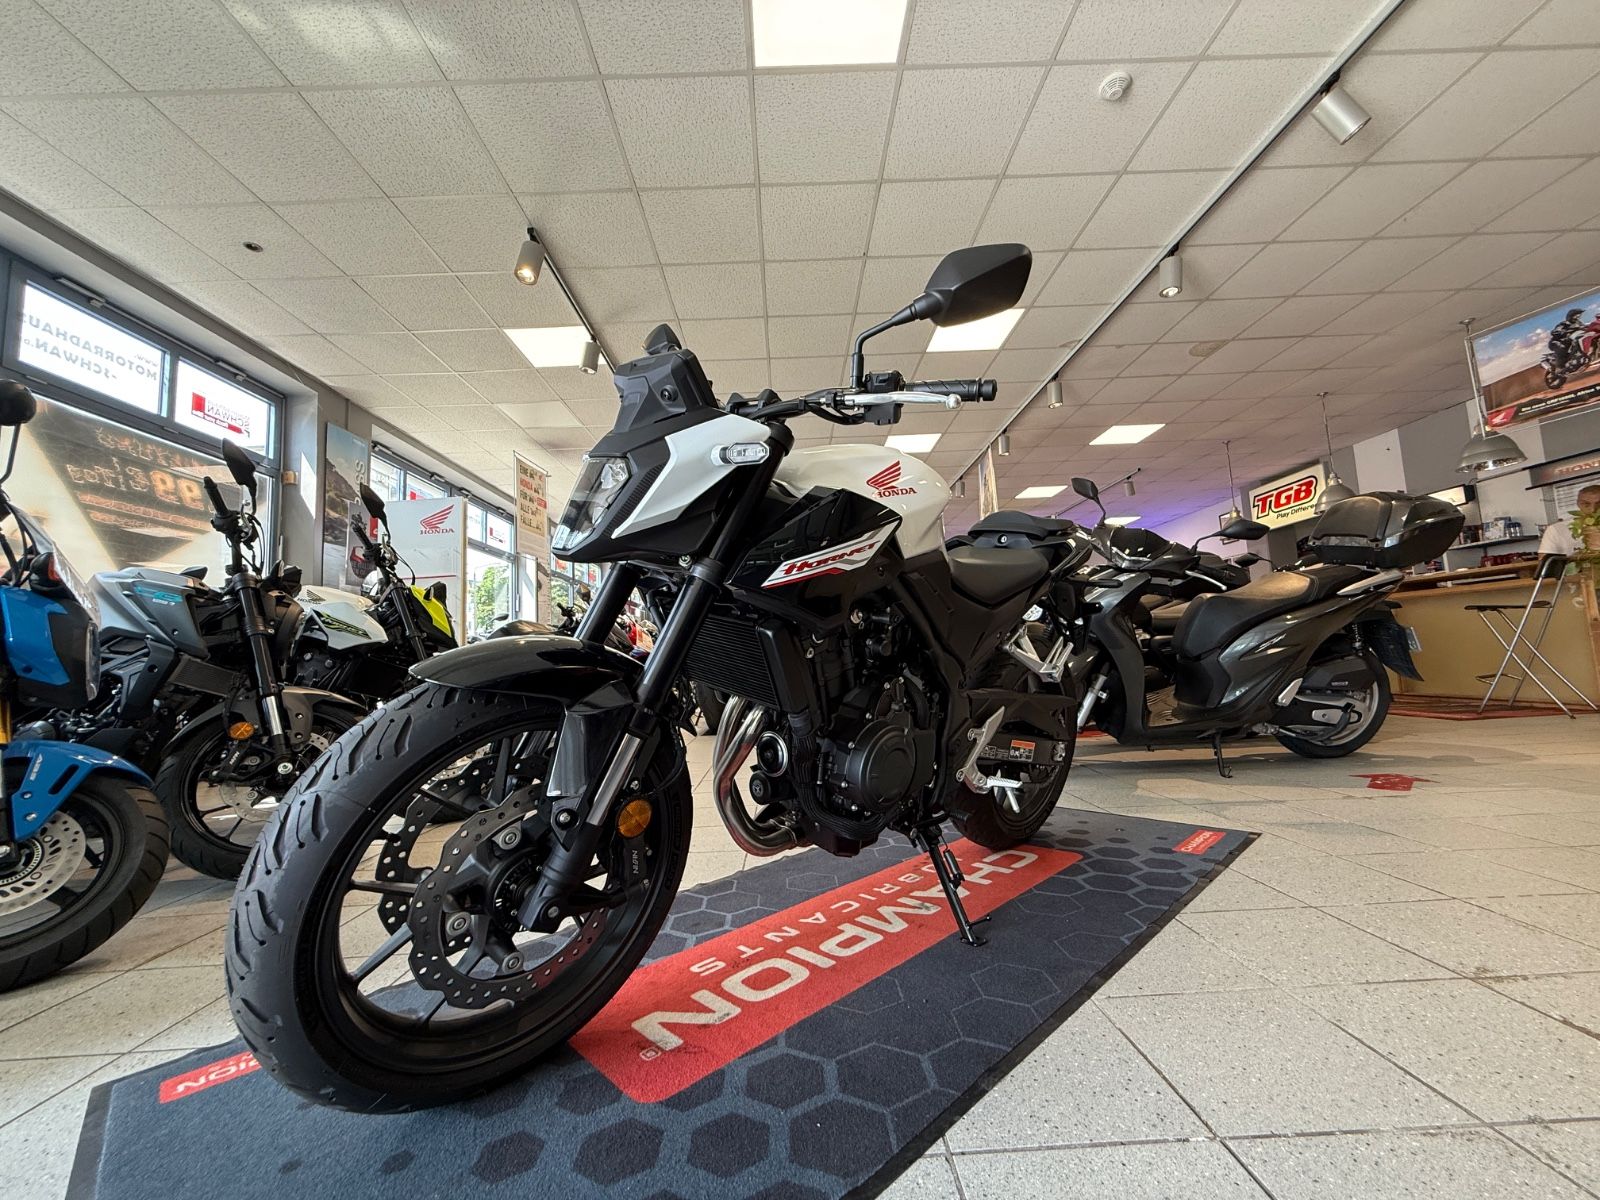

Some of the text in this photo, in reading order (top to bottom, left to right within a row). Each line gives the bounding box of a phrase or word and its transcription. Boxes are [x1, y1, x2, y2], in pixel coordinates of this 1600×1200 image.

[873, 486, 917, 498] HONDA
[1255, 476, 1317, 516] TGB
[1276, 511, 1290, 520] Play
[419, 528, 455, 536] HONDA
[630, 849, 1039, 1052] CHAMPION
